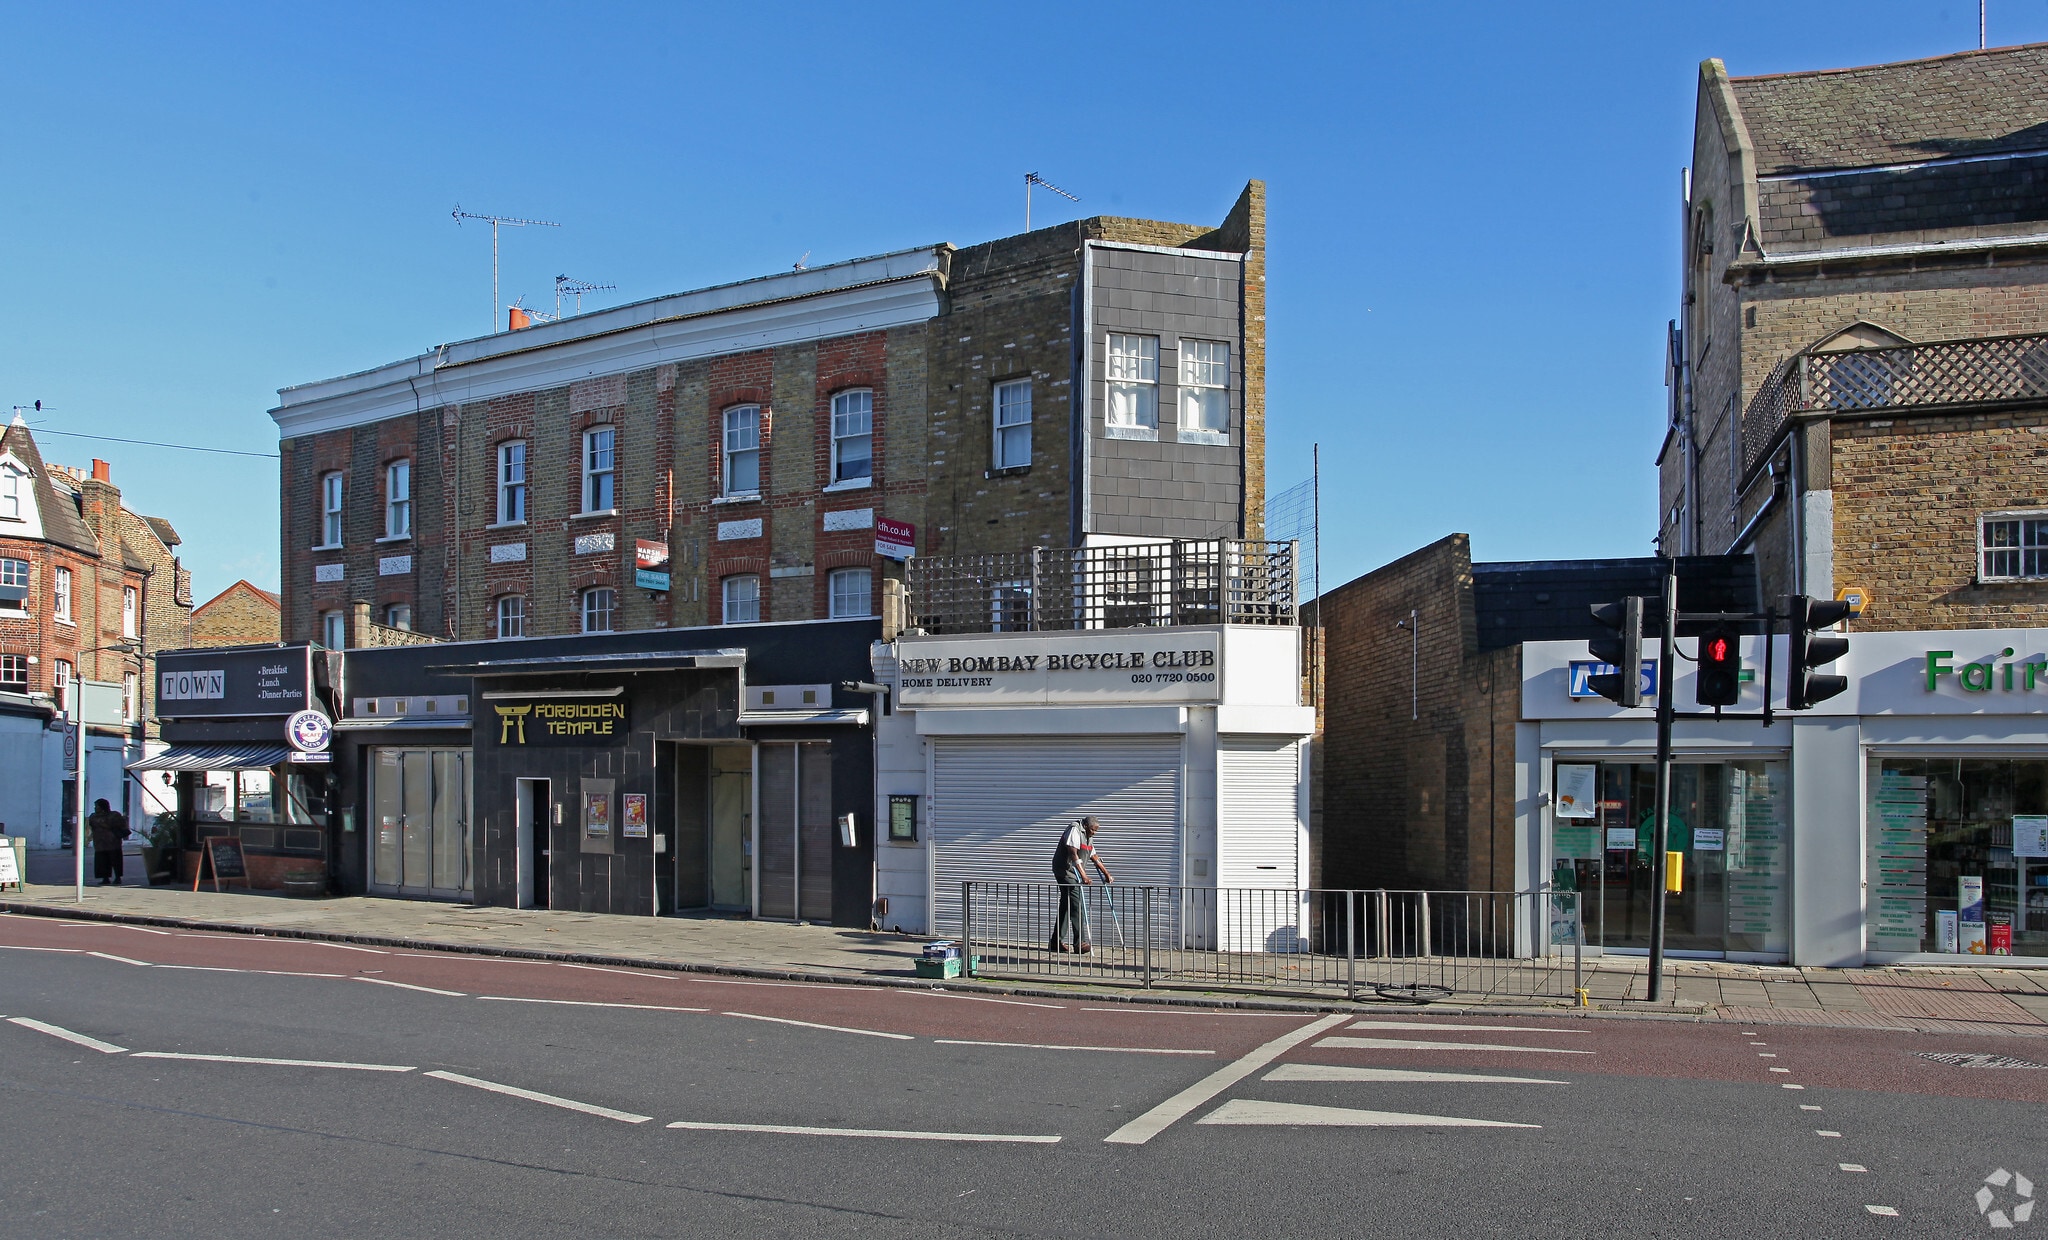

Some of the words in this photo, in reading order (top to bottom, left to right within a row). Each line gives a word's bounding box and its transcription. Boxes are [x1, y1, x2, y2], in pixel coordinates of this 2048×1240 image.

[877, 521, 911, 537] kfh.co.uk
[637, 547, 661, 557] MARSH
[637, 553, 668, 563] PARSONS
[637, 571, 649, 579] FOR
[901, 658, 941, 673] NEW
[948, 655, 1038, 673] BOMBAY
[1047, 652, 1144, 671] BICYCLE
[1153, 650, 1214, 668] CLUB
[261, 665, 288, 675] Breakfast
[261, 677, 280, 687] Lunch
[901, 678, 933, 687] HOME
[937, 677, 992, 687] DELIVERY
[1131, 673, 1152, 683] 020
[1155, 673, 1182, 683] 7720
[1186, 672, 1215, 682] 0500
[165, 675, 222, 695] TOWN
[261, 690, 282, 699] Dinner
[282, 689, 302, 698] Parties
[535, 702, 625, 719] FORBIDDEN
[294, 713, 328, 734] EXCELLENCE
[546, 720, 613, 736] TEMPLE
[301, 740, 322, 748] BLEND
